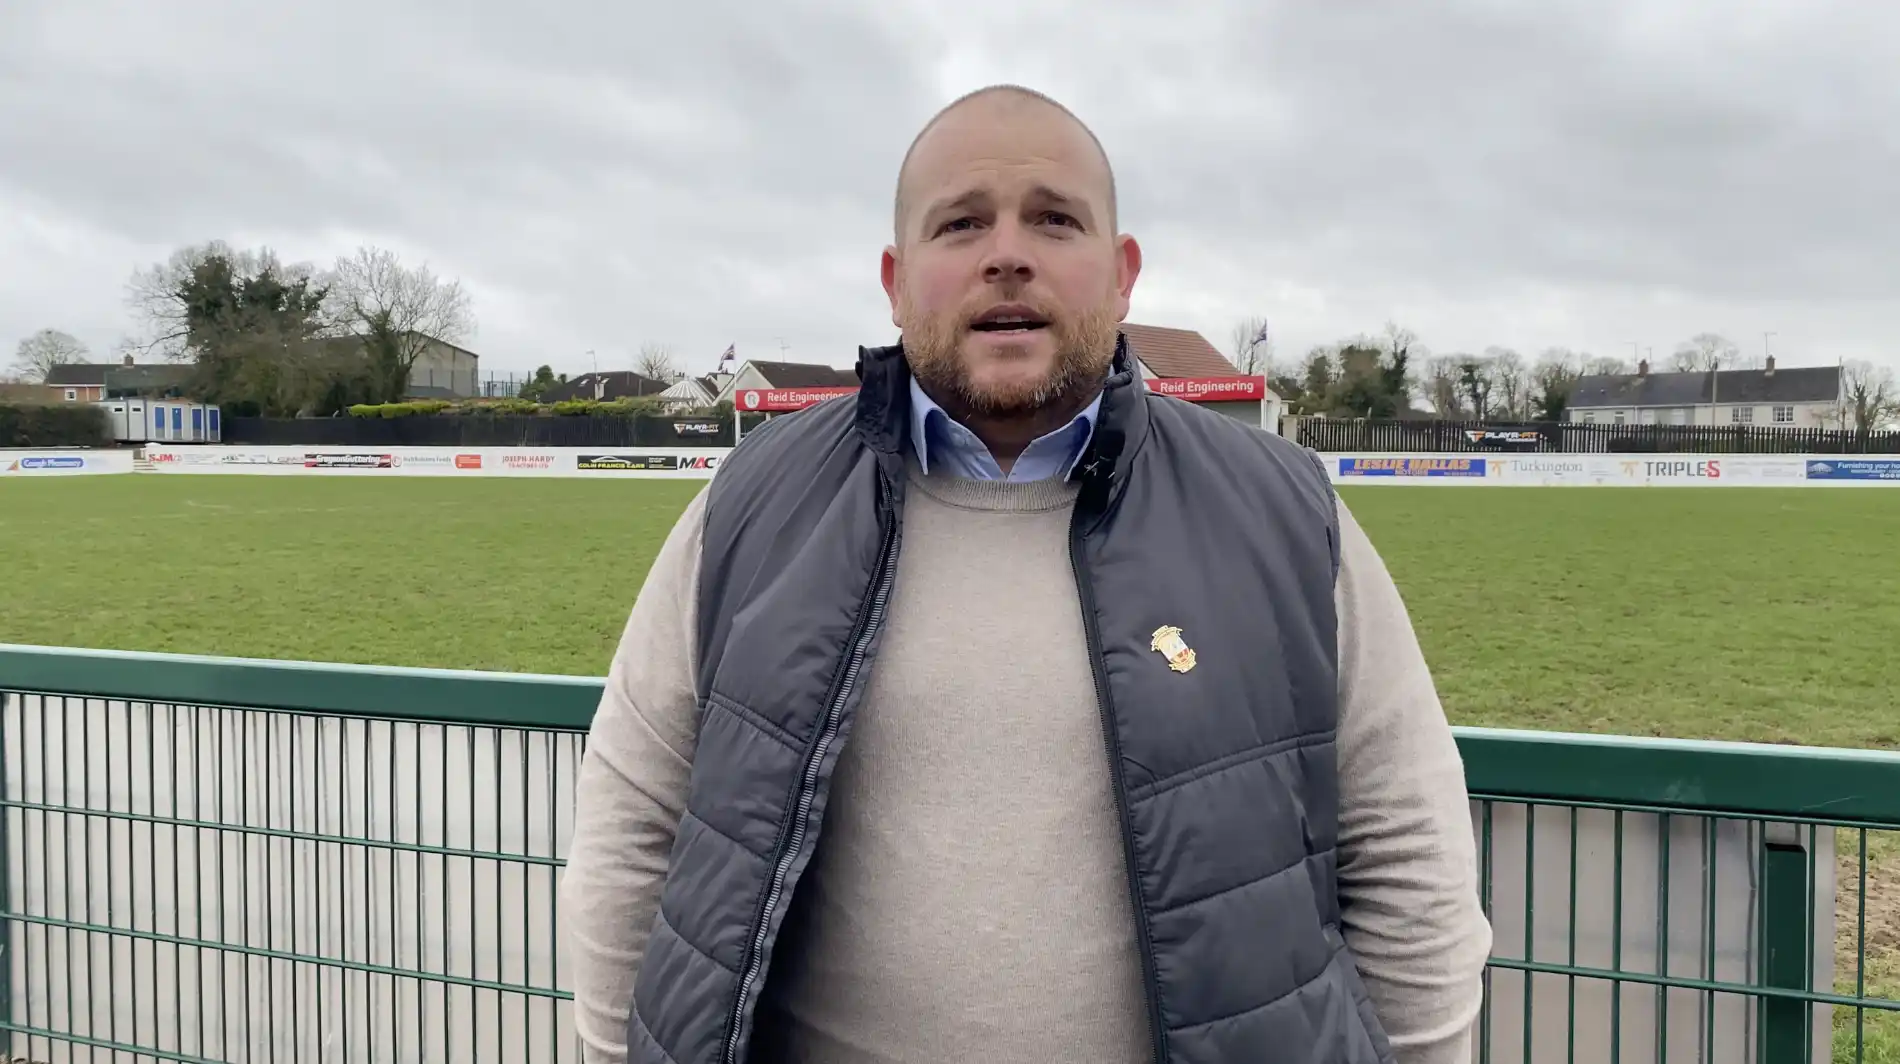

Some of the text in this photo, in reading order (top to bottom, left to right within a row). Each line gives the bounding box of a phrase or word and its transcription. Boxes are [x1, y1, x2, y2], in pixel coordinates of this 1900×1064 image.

[1160, 380, 1254, 393] Reid Engineering
[767, 392, 788, 402] Reid
[502, 456, 527, 464] JOSEPH
[1354, 459, 1405, 470] LESLIE
[1511, 460, 1583, 476] Turkington
[1837, 462, 1873, 471] Furnishing
[1875, 463, 1890, 471] your
